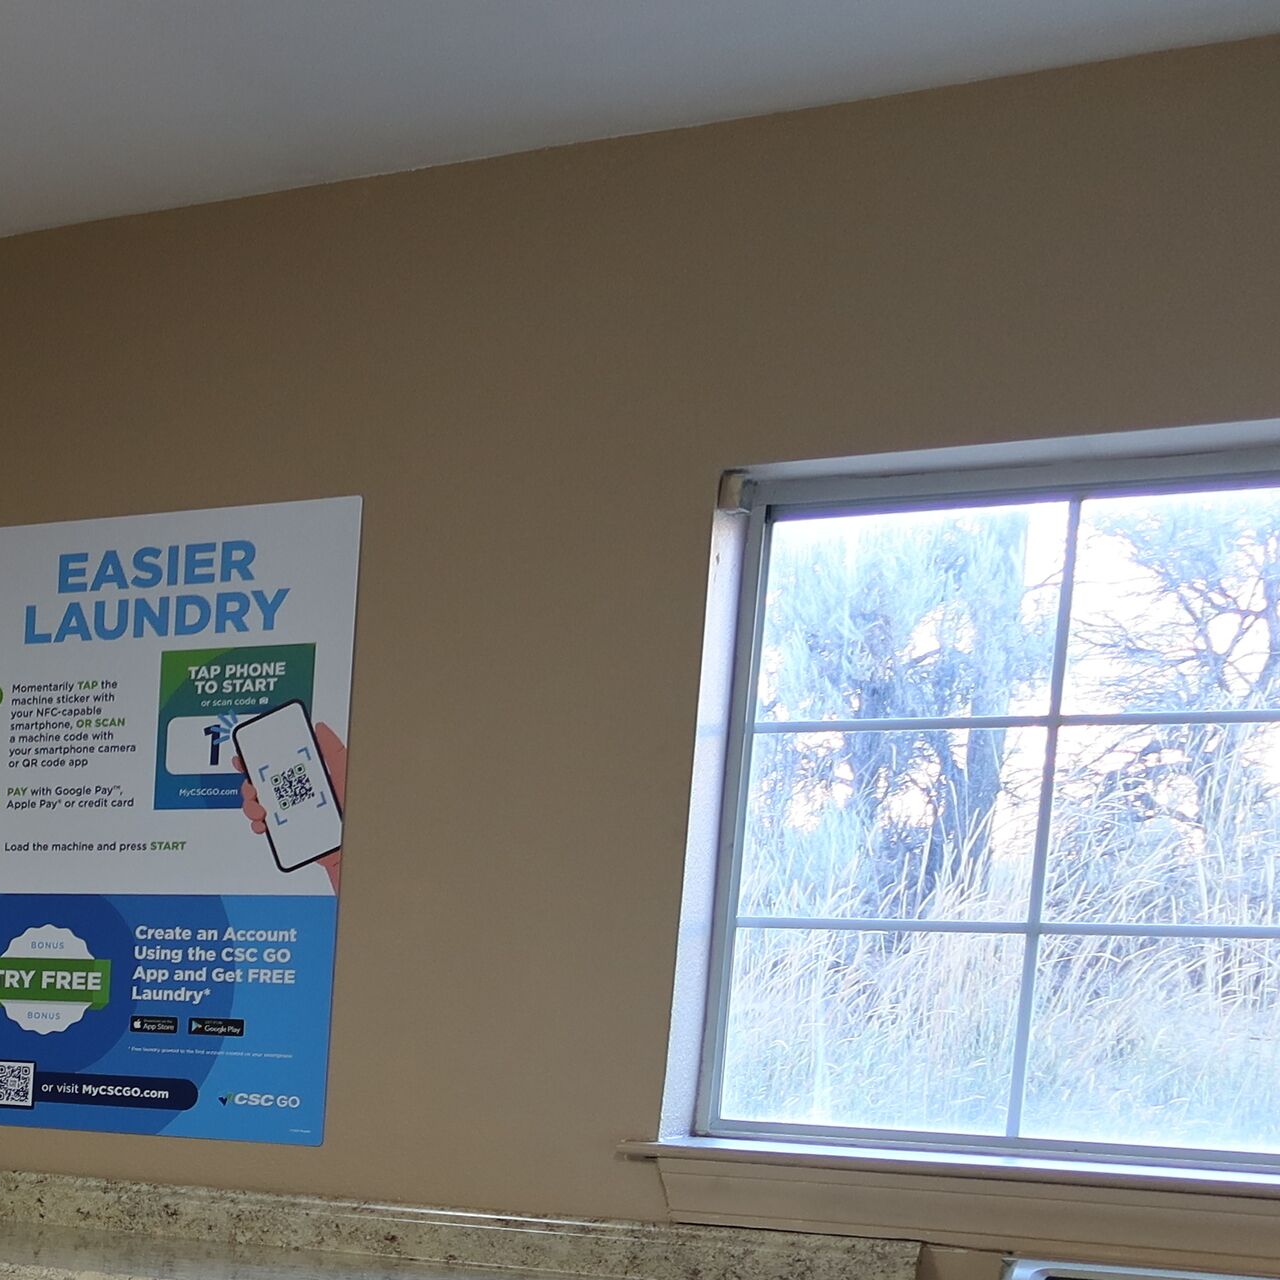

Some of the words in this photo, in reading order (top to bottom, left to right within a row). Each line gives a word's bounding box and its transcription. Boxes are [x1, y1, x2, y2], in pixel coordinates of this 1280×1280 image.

[57, 540, 256, 594] EASIER
[24, 588, 290, 645] LAUNDRY
[188, 666, 220, 680] TAP
[225, 662, 286, 678] PHONE
[12, 682, 74, 693] Momentarily
[77, 681, 99, 690] TAP
[101, 680, 117, 689] the
[195, 681, 218, 694] TO
[222, 678, 278, 693] START
[11, 695, 53, 705] machine
[56, 694, 90, 703] sticker
[93, 693, 115, 702] with
[212, 699, 232, 707] scan
[11, 710, 33, 720] your
[36, 706, 102, 717] NFC-capable
[10, 720, 73, 730] smartphone,
[76, 719, 92, 728] OR
[95, 718, 125, 727] SCAN
[19, 733, 60, 743] machine
[63, 732, 88, 741] code
[92, 731, 113, 740] with
[9, 747, 32, 757] your
[34, 744, 95, 756] smartphone
[98, 744, 136, 753] camera
[204, 724, 221, 765] 1
[9, 760, 19, 768] or
[22, 759, 38, 767] QR
[41, 758, 66, 767] code
[68, 759, 88, 768] app
[7, 787, 28, 796] PAY
[30, 787, 52, 796] with
[55, 787, 92, 798] Google
[179, 788, 238, 797] MyCSCGO.com
[7, 800, 36, 810] Apple
[64, 800, 74, 808] or
[78, 799, 108, 808] credit
[111, 798, 134, 807] card
[5, 842, 29, 852] Load
[32, 843, 48, 851] the
[52, 842, 94, 851] machine
[97, 842, 116, 851] and
[119, 842, 147, 853] press
[150, 841, 186, 851] START
[135, 925, 192, 941] Create
[196, 928, 218, 941] an
[223, 927, 297, 942] Account
[31, 941, 64, 949] BONUS
[134, 945, 182, 963] Using
[188, 946, 216, 961] the
[221, 947, 258, 962] CSC
[263, 948, 291, 963] GO
[41, 970, 102, 990] FREE
[132, 965, 169, 983] App
[174, 967, 207, 981] and
[211, 968, 243, 982] Get
[248, 968, 296, 984] FREE
[27, 1011, 60, 1020] BONUS
[143, 1023, 156, 1031] App
[204, 1024, 227, 1033] Google
[228, 1025, 241, 1034] Play
[41, 1083, 53, 1092] or
[57, 1083, 78, 1094] visit
[82, 1084, 169, 1098] MyCSCGO.com
[234, 1093, 274, 1106] CSC
[277, 1095, 300, 1108] GO
